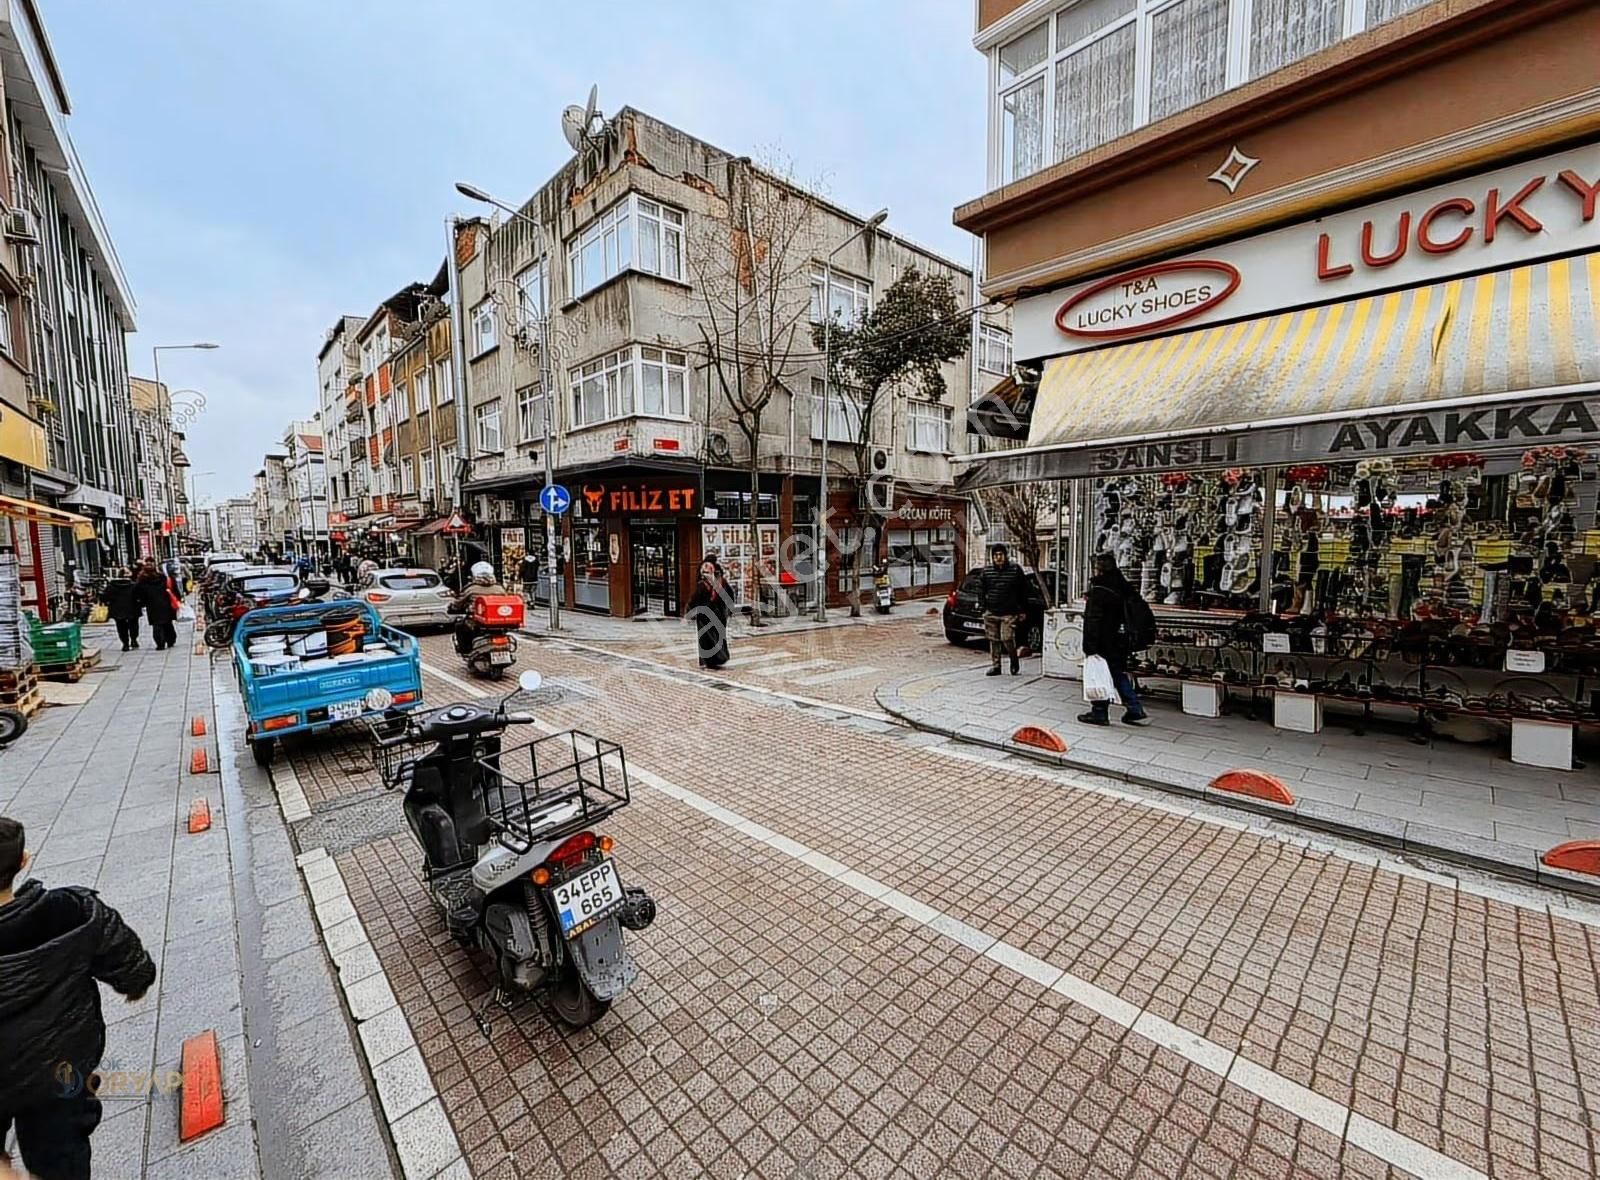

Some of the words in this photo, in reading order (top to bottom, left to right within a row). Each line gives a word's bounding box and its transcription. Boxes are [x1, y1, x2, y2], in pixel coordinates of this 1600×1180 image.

[1318, 169, 1600, 280] LUCKY
[1078, 302, 1137, 328] LUCKY
[1141, 286, 1211, 314] SHOES
[1122, 276, 1158, 298] T&A
[1328, 400, 1599, 453] AYAKKA
[610, 485, 663, 512] FİLİZ
[668, 488, 694, 510] ET
[557, 864, 611, 906] 34EPP
[580, 885, 613, 916] 665
